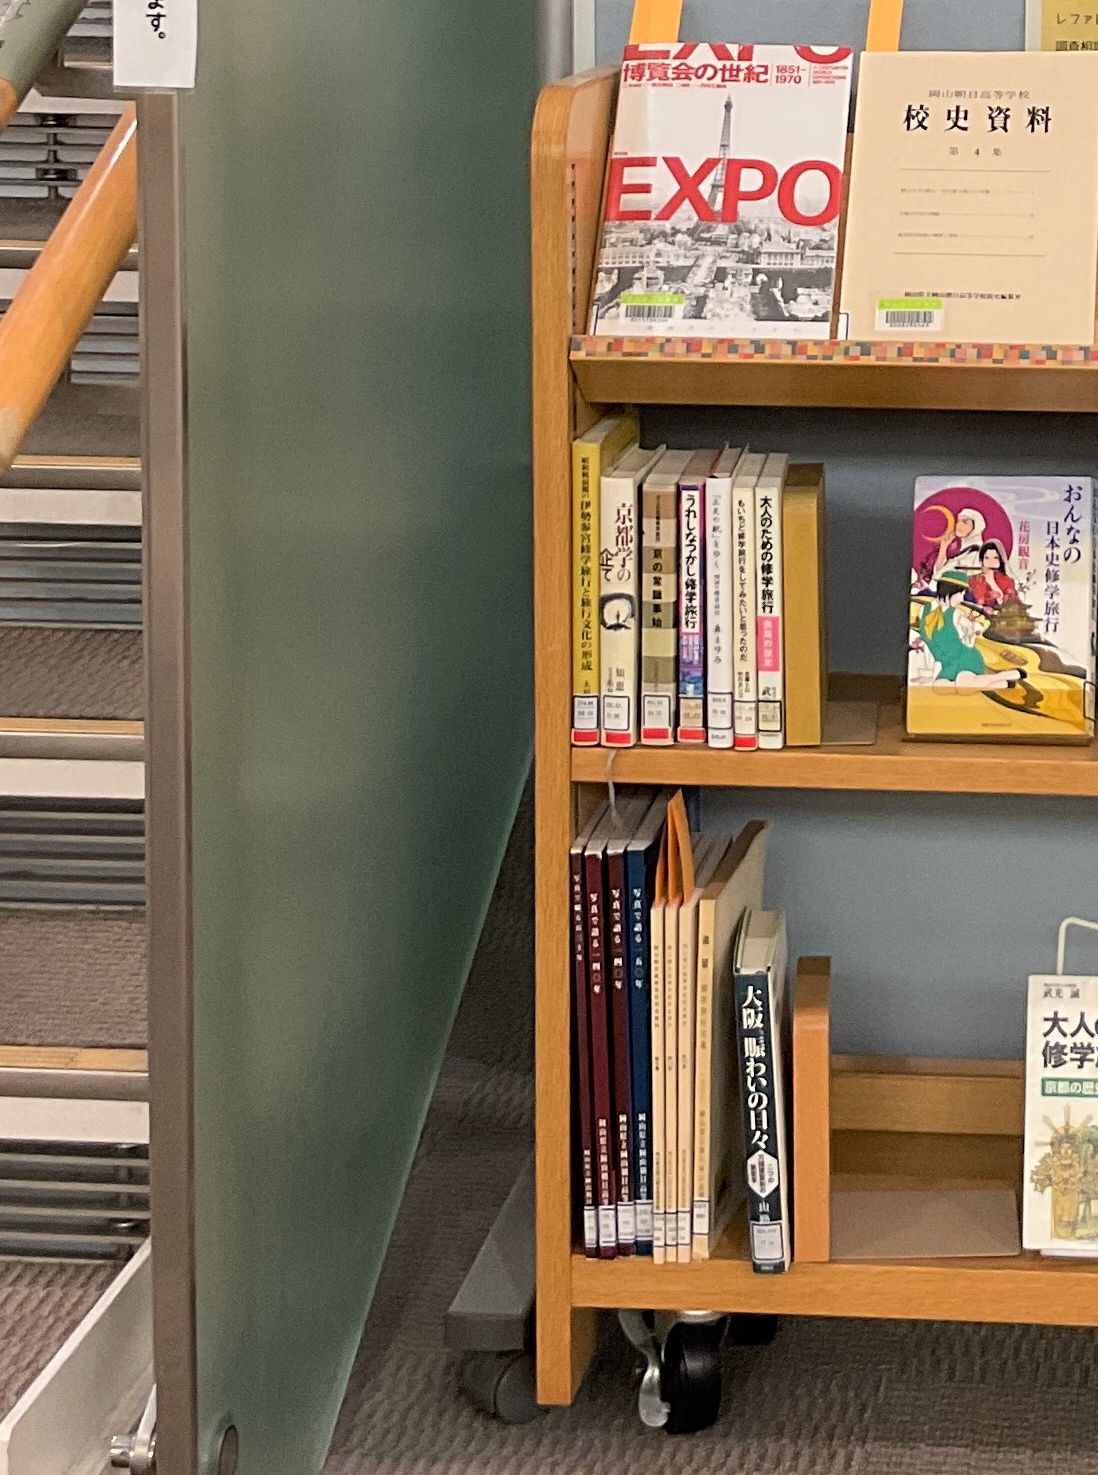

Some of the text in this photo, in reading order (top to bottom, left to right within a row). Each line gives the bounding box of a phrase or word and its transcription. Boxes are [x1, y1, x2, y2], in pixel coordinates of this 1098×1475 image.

[623, 62, 769, 84] 博覧会の世紀
[775, 75, 801, 85] 1970
[903, 104, 1052, 134] 校史資料
[603, 157, 843, 226] EXPO
[760, 496, 774, 614] 大人のための修学旅行
[1063, 484, 1083, 564] おんなの
[1045, 521, 1060, 633] 日本史修学旅行
